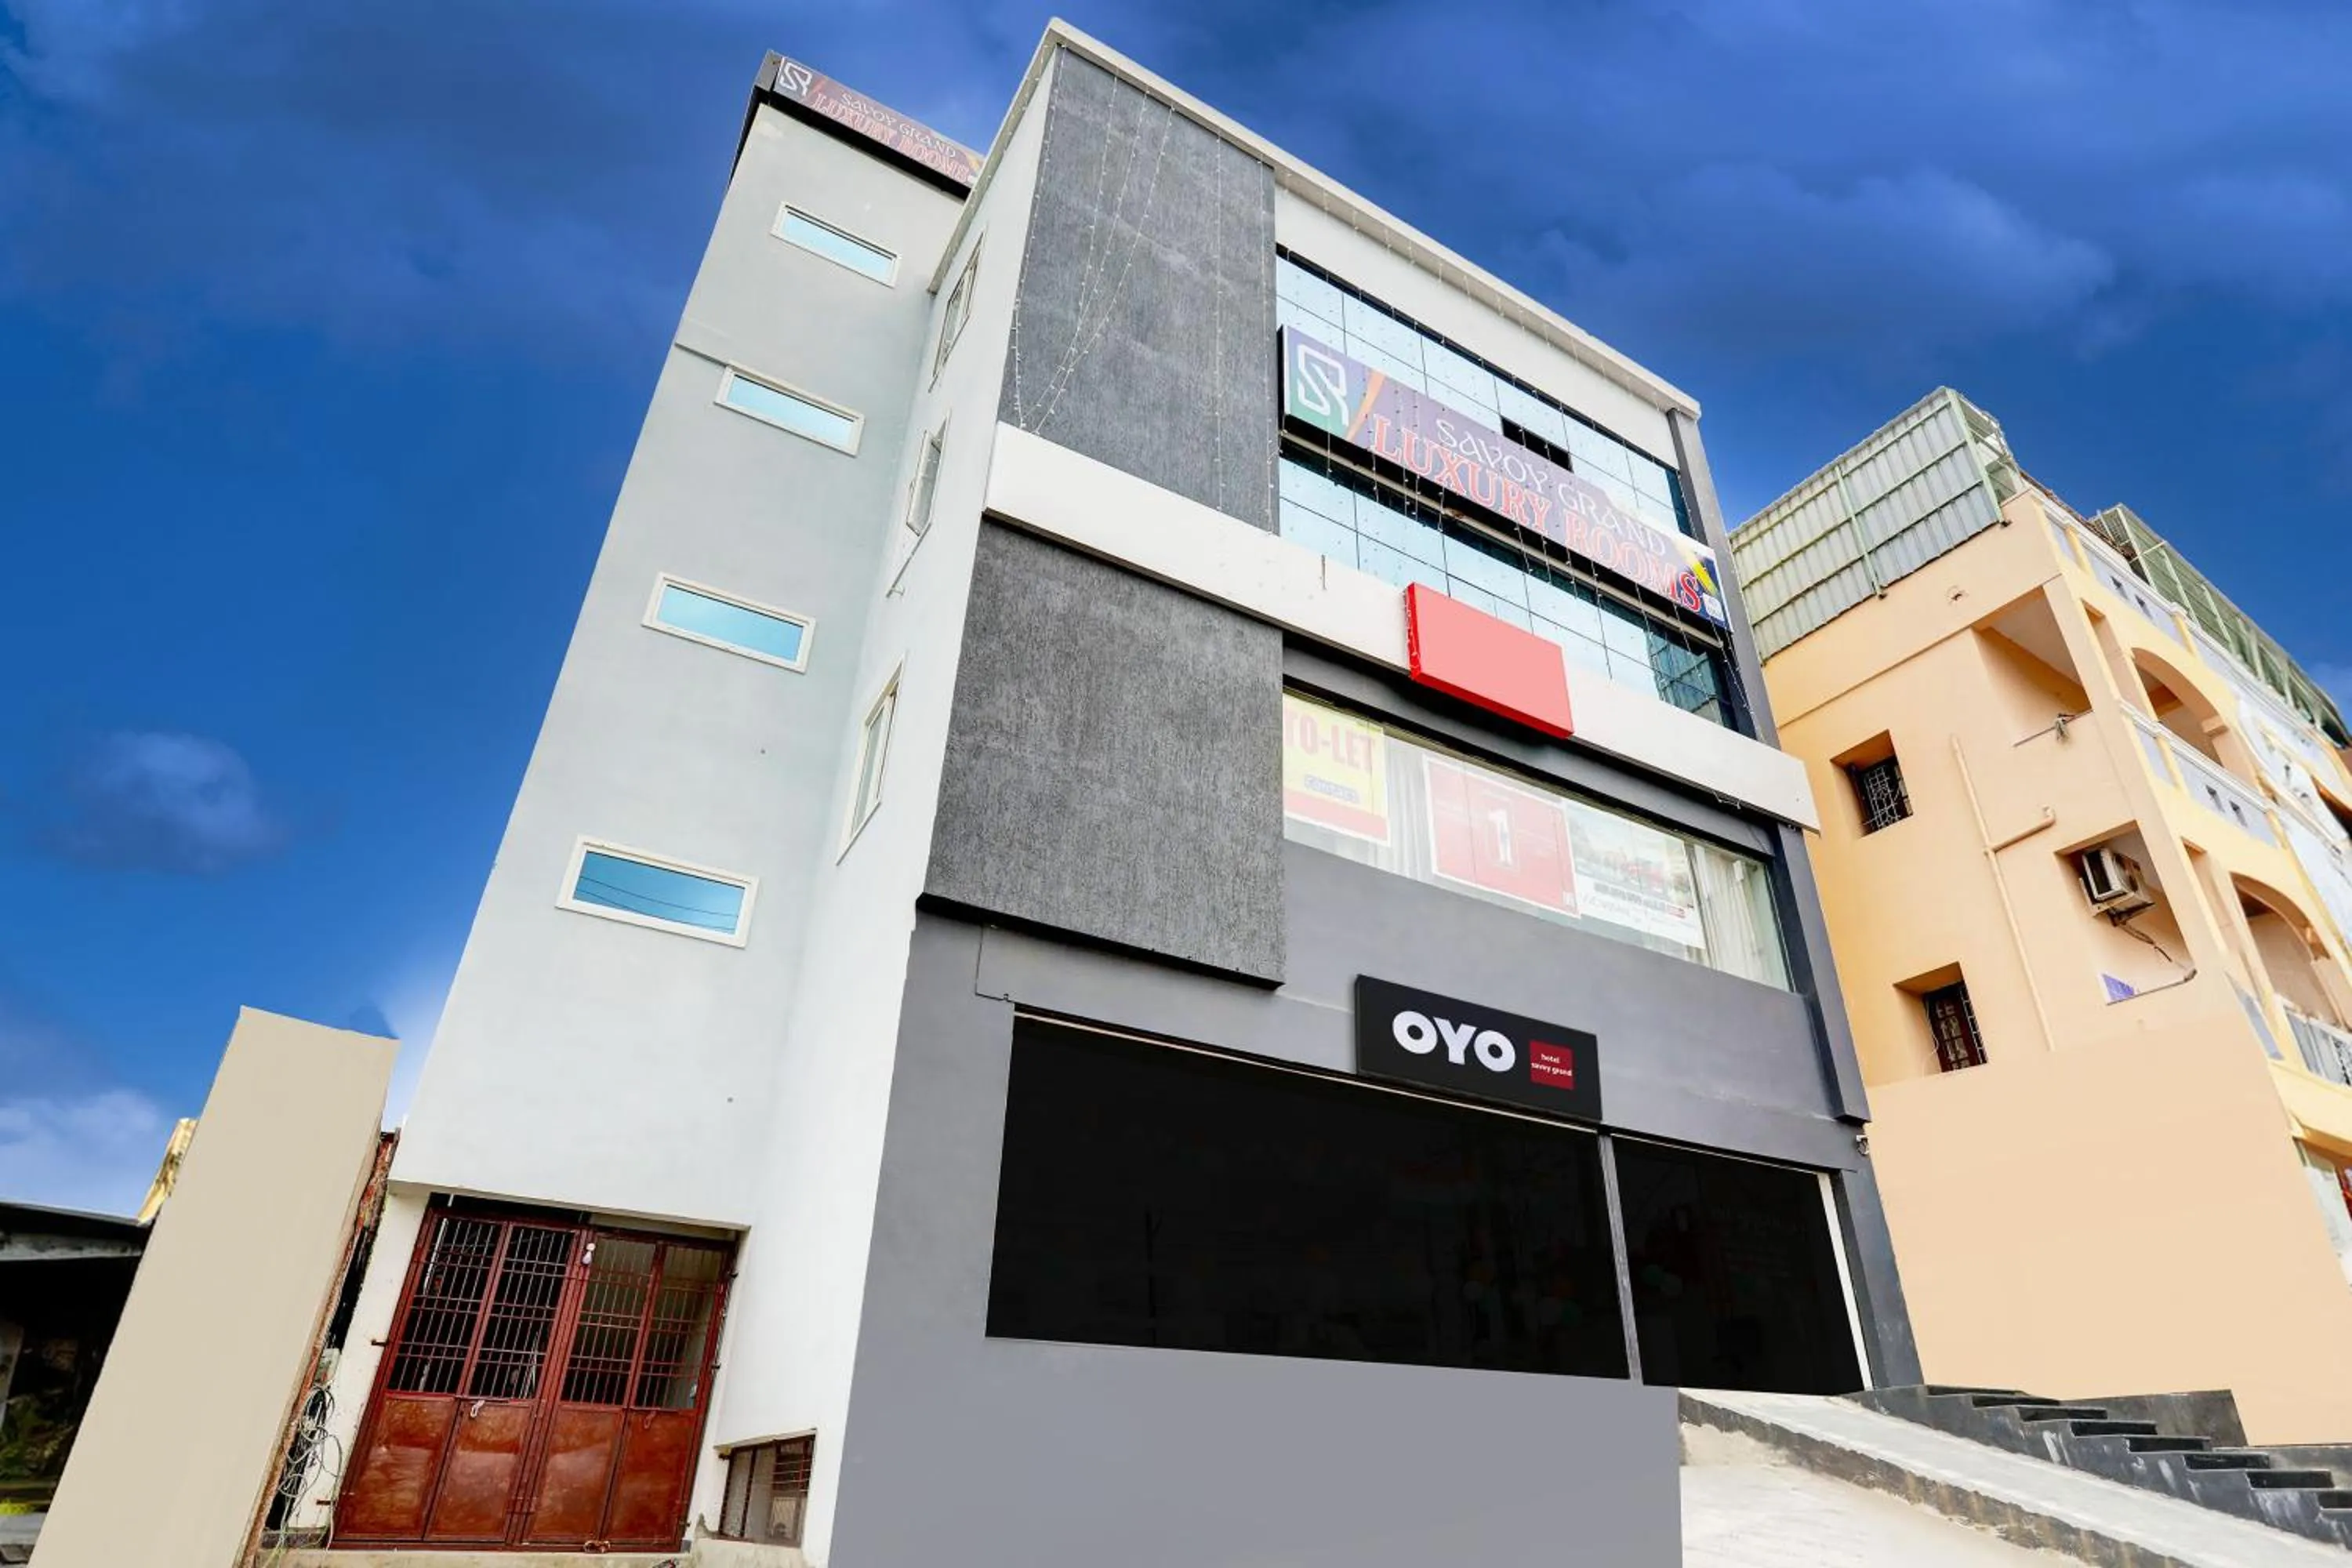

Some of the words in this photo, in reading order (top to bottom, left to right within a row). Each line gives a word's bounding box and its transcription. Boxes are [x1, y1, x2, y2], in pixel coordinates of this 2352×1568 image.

[813, 93, 898, 147] LUXURY
[898, 136, 969, 182] ROOMS
[898, 122, 957, 158] GRAND
[1371, 412, 1554, 535] LUXURY
[1563, 510, 1702, 613] ROOMS
[1556, 482, 1667, 557] GRAND
[1283, 702, 1375, 774] TO-LET
[1392, 1011, 1516, 1073] OYO
[1541, 1053, 1560, 1064] hotel
